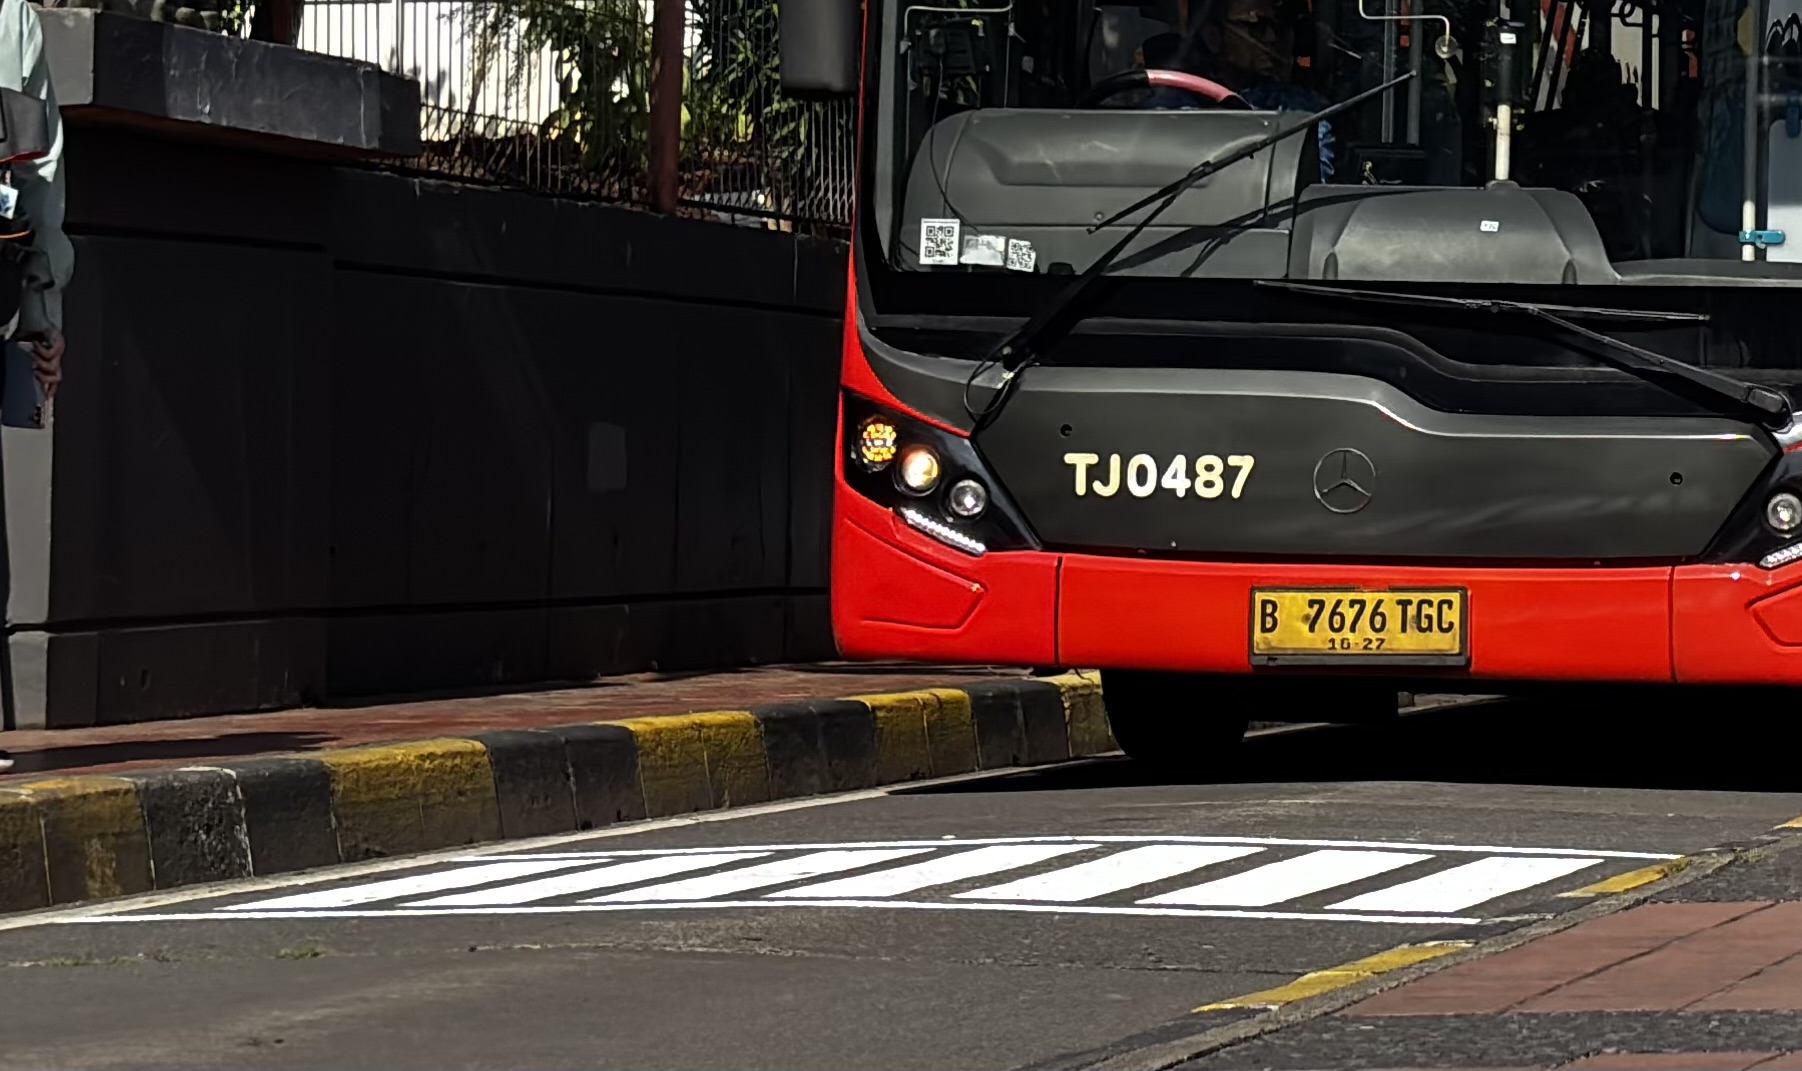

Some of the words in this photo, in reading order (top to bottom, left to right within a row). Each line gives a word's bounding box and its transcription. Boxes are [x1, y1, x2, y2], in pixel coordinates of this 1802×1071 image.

[1063, 452, 1255, 499] TJ0487
[1260, 598, 1279, 634] B
[1307, 598, 1387, 634] 7676
[1396, 598, 1455, 634] TGC
